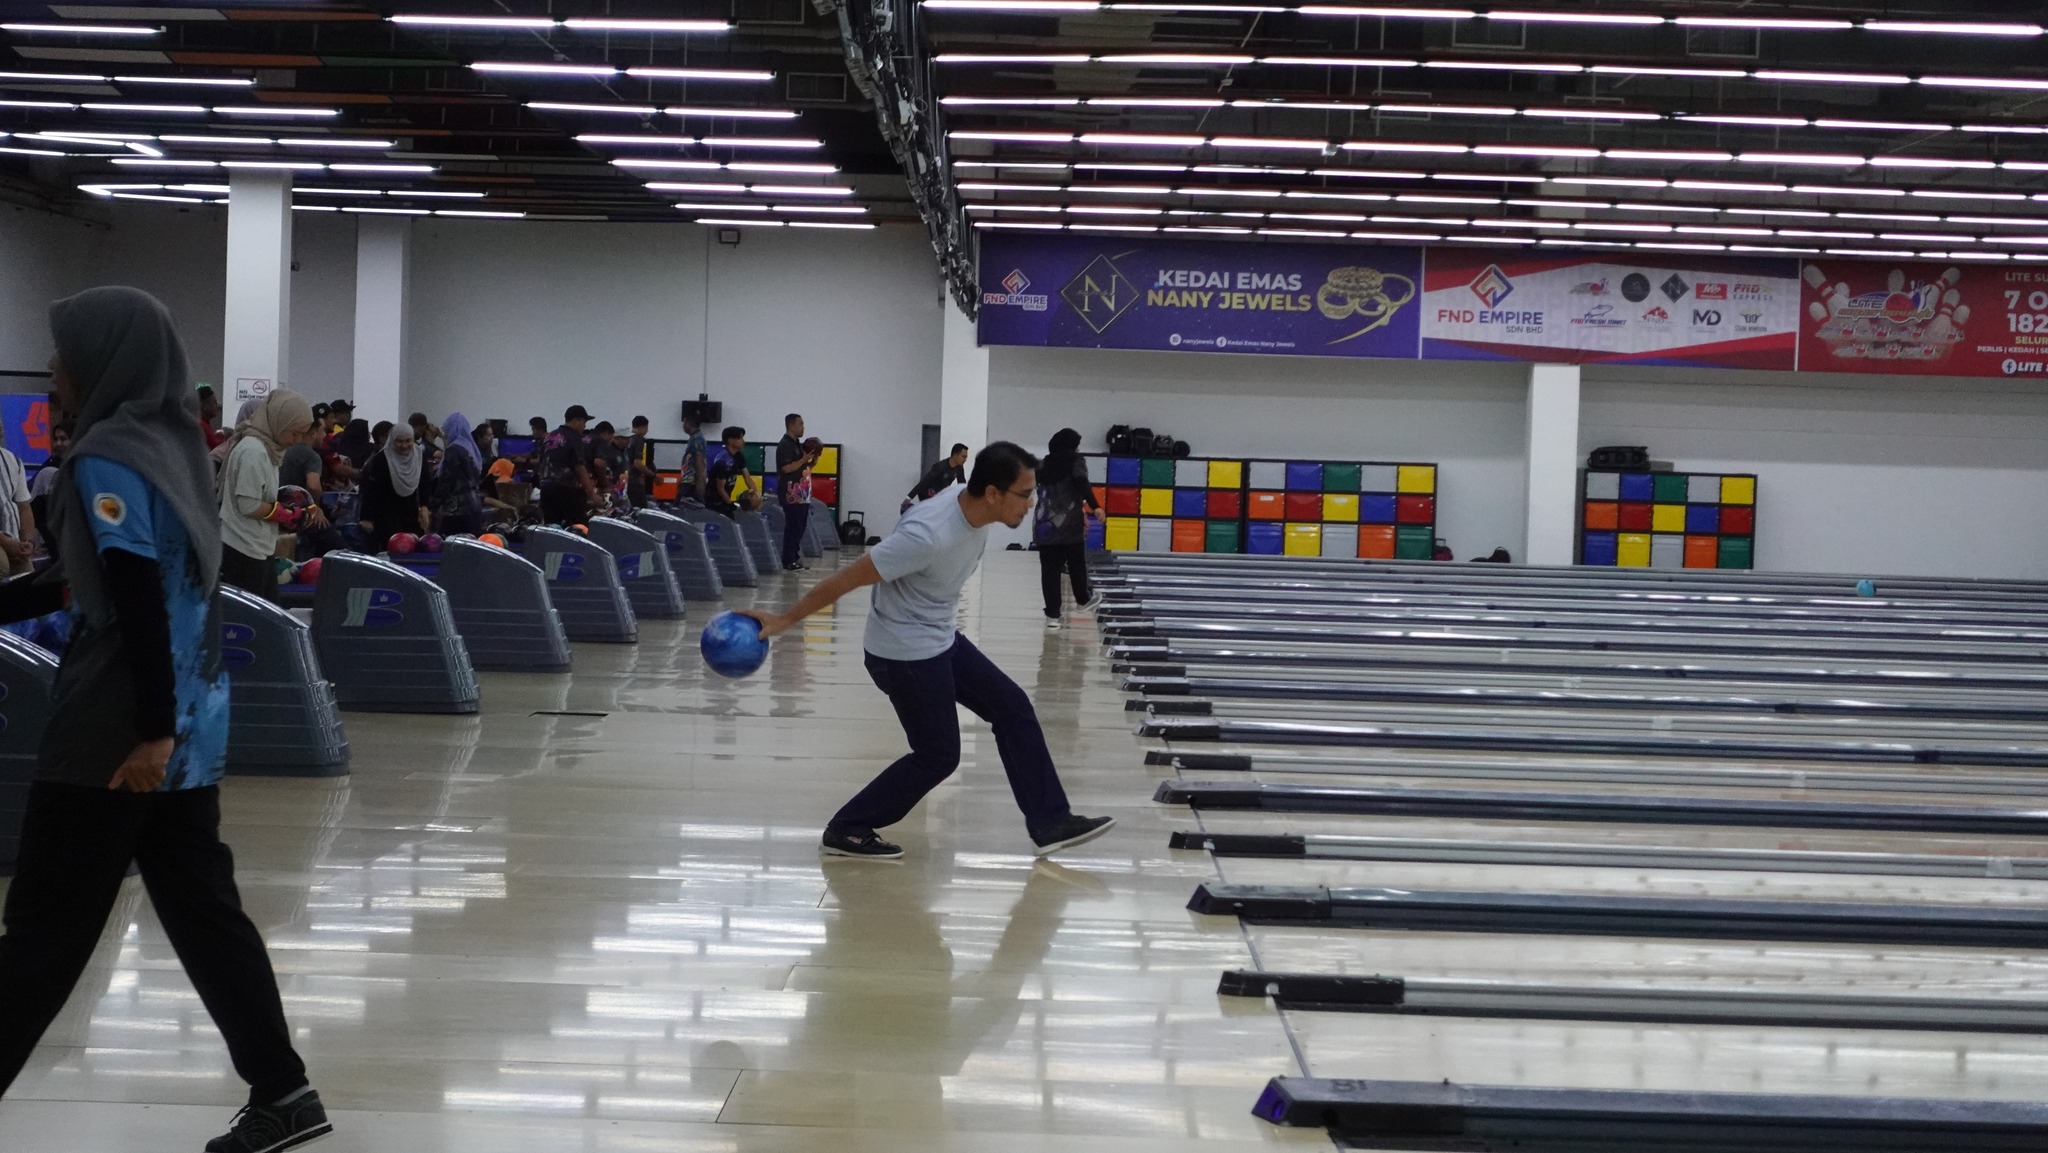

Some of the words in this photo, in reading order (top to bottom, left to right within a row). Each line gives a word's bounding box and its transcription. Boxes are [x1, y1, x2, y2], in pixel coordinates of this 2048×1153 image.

[1158, 269, 1230, 288] KEDAI
[1237, 272, 1302, 291] EMAS
[2005, 272, 2031, 281] LITE
[984, 293, 1007, 304] FND
[1007, 294, 1047, 305] EMPIRE
[1147, 289, 1214, 308] NANY
[1218, 292, 1312, 311] JEWELS
[2004, 290, 2021, 310] 7
[1438, 309, 1475, 324] FND
[1479, 310, 1544, 325] EMPIRE
[1692, 308, 1722, 326] MD
[1505, 325, 1524, 334] SDN
[1526, 326, 1544, 334] BHD
[2017, 361, 2043, 373] LITE
